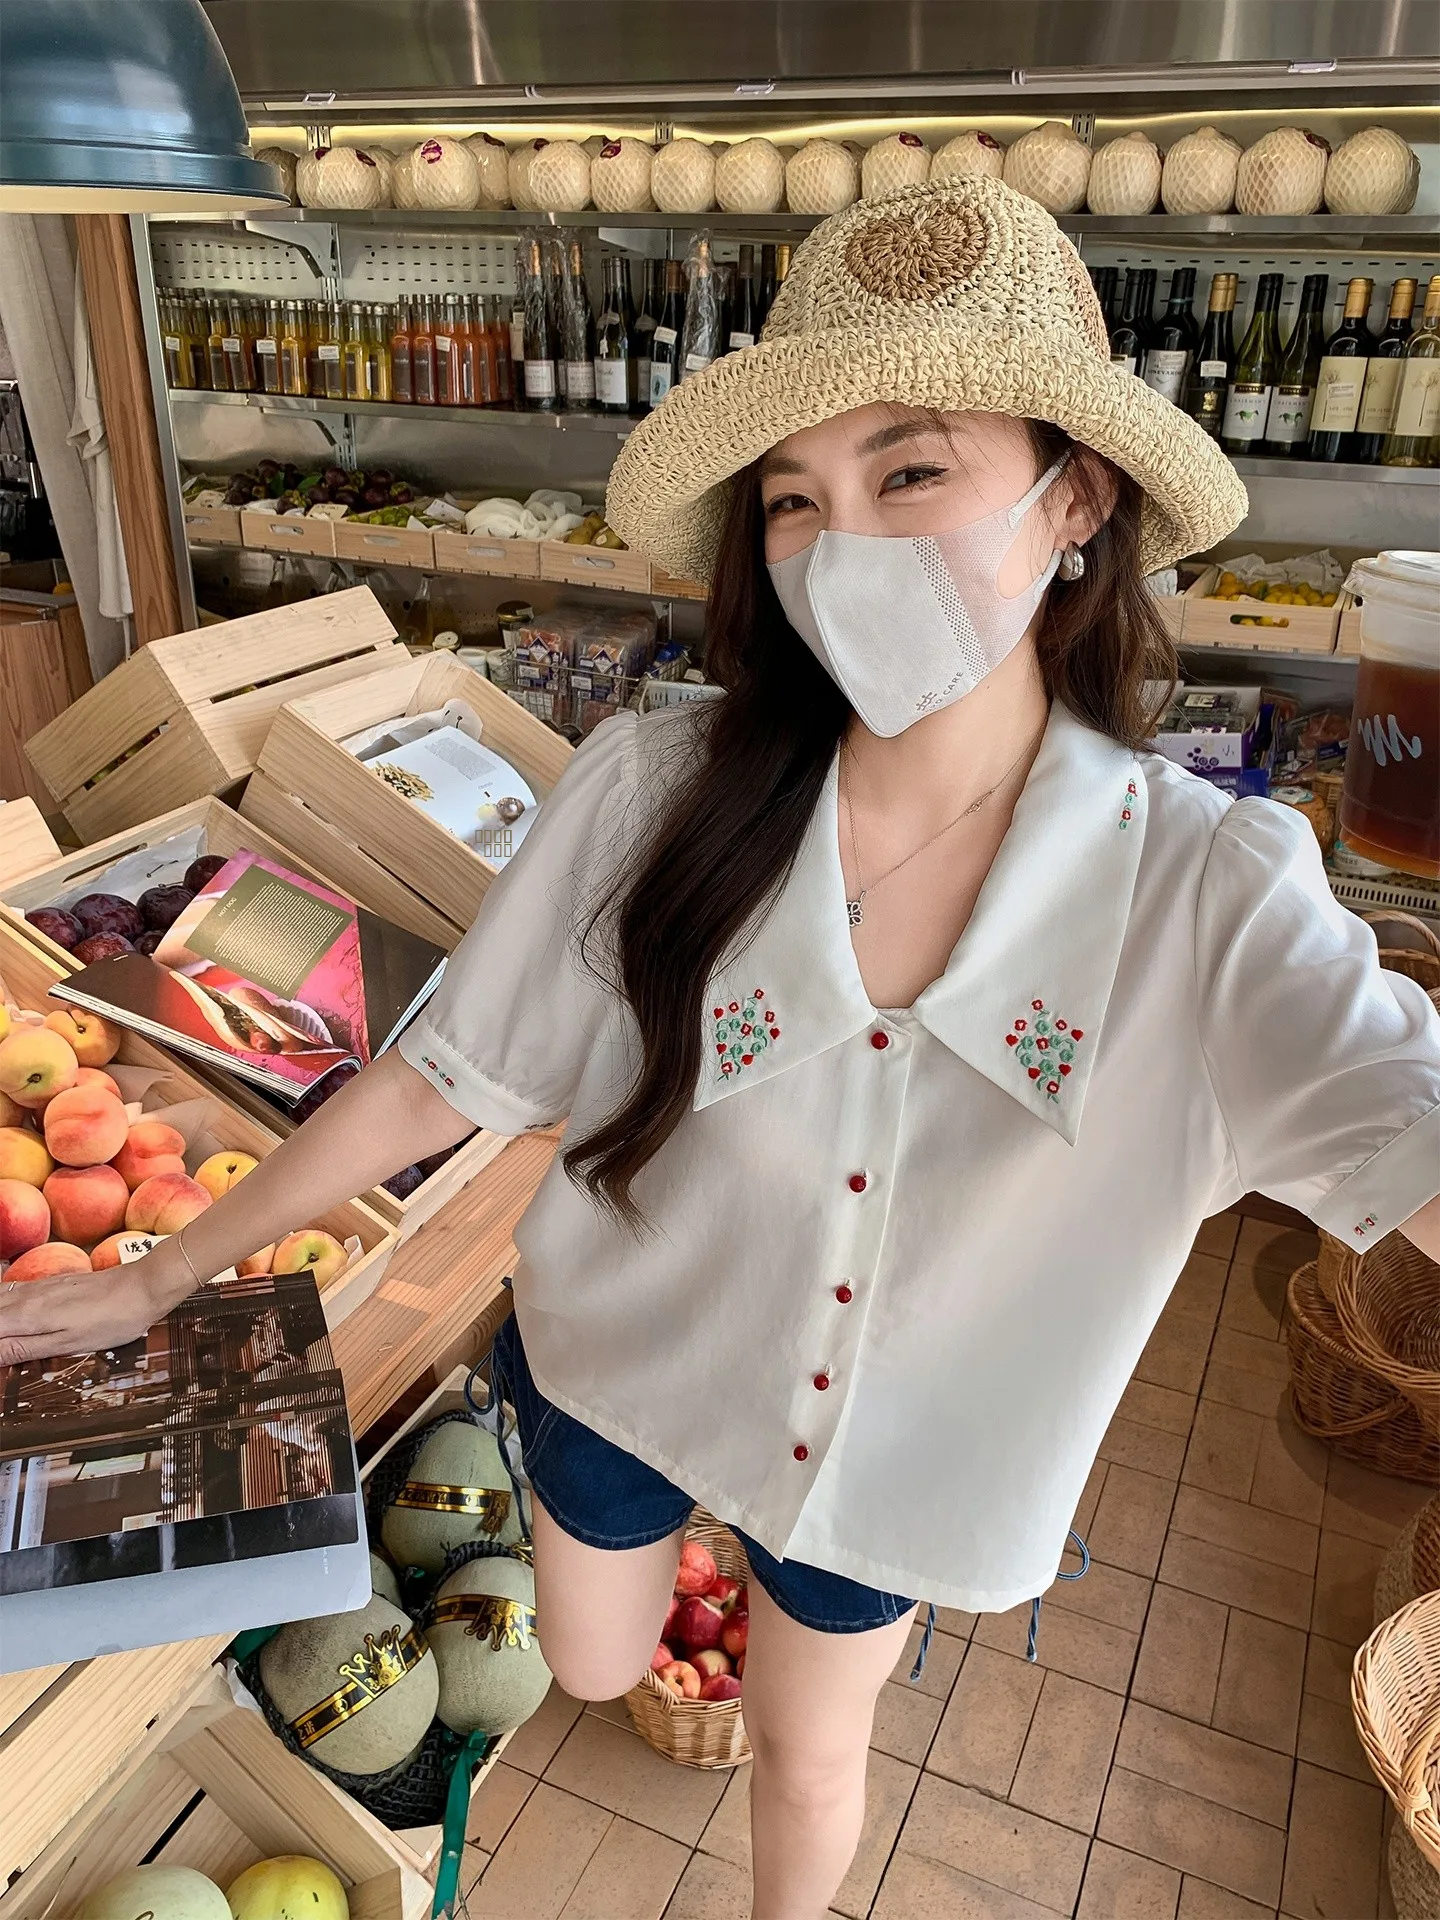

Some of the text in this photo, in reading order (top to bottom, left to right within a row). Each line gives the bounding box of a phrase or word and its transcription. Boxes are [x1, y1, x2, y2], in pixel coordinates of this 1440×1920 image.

[943, 672, 963, 695] CARE
[218, 897, 237, 918] HOT DOG
